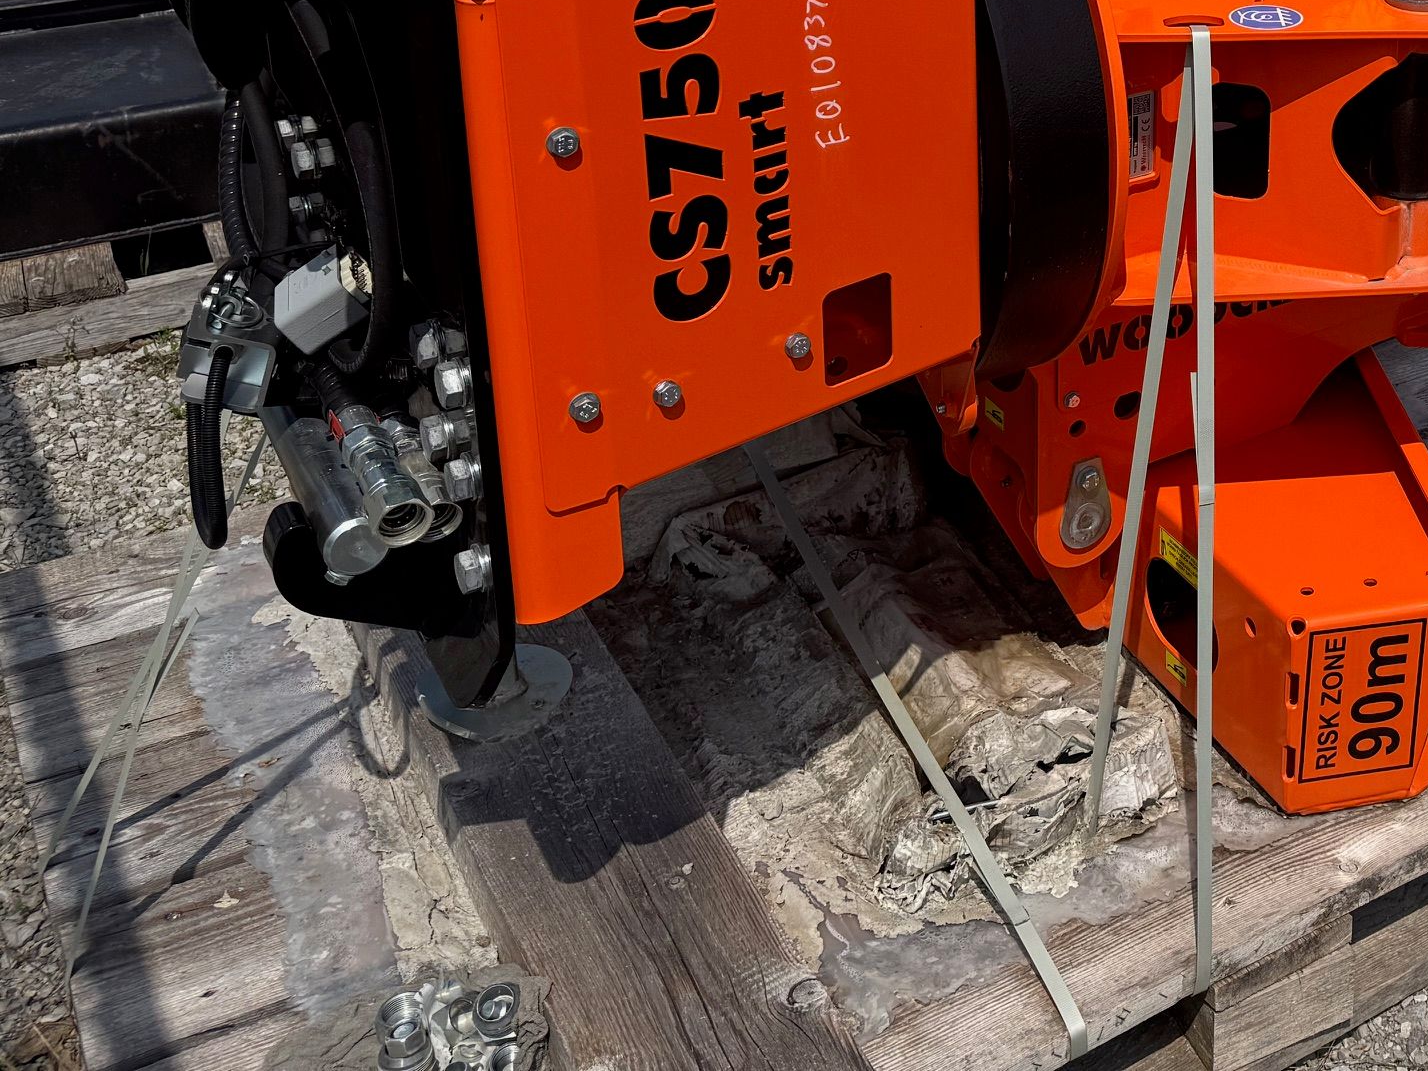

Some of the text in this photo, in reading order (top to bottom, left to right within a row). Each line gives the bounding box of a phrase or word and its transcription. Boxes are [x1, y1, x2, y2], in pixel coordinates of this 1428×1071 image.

[737, 90, 794, 292] smart
[1315, 636, 1348, 770] RISK ZONE
[1347, 633, 1410, 761] 90m
